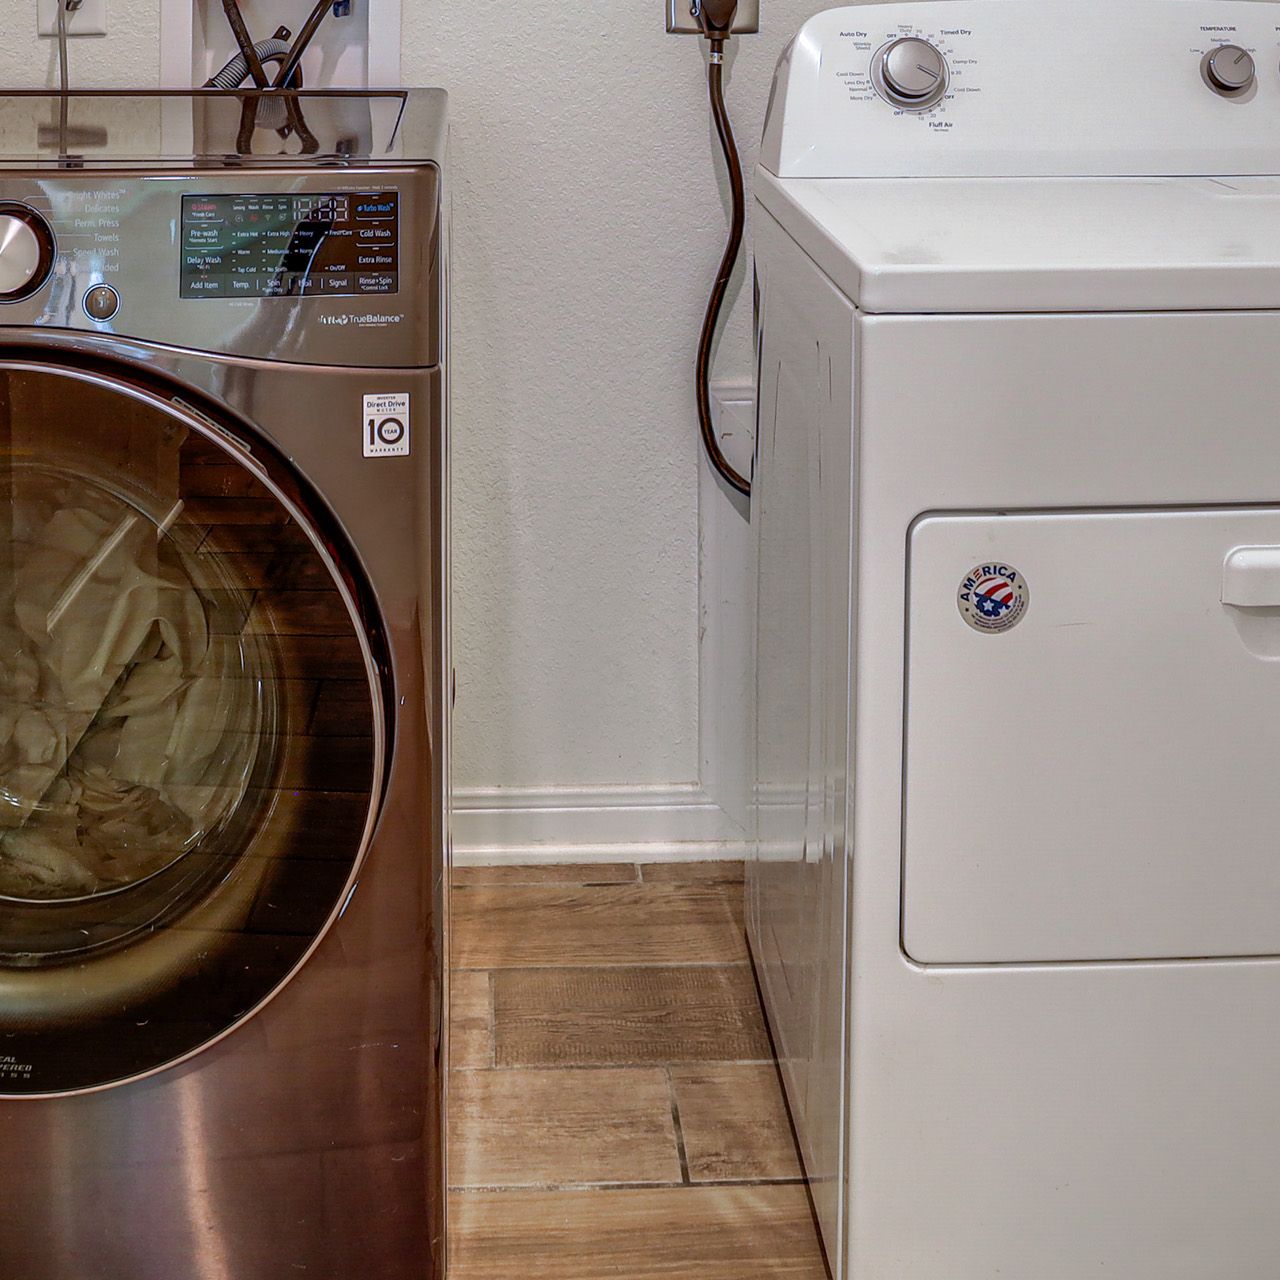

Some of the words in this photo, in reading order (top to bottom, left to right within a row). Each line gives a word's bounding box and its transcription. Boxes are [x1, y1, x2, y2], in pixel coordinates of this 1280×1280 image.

[84, 204, 120, 213] Delicates
[98, 219, 120, 228] Press
[94, 233, 120, 242] Towels
[359, 230, 374, 238] Cold
[72, 248, 96, 258] Speed
[98, 248, 120, 257] Wash
[187, 256, 204, 265] Delay
[205, 256, 222, 264] Wash
[358, 256, 375, 264] Extra
[375, 256, 392, 264] Rinse
[190, 281, 205, 289] Add
[205, 281, 219, 289] Item
[233, 281, 250, 289] Temp.
[267, 280, 280, 288] Spin
[329, 280, 348, 288] Signal
[368, 417, 405, 445] 10
[960, 565, 1017, 602] AMERICA
